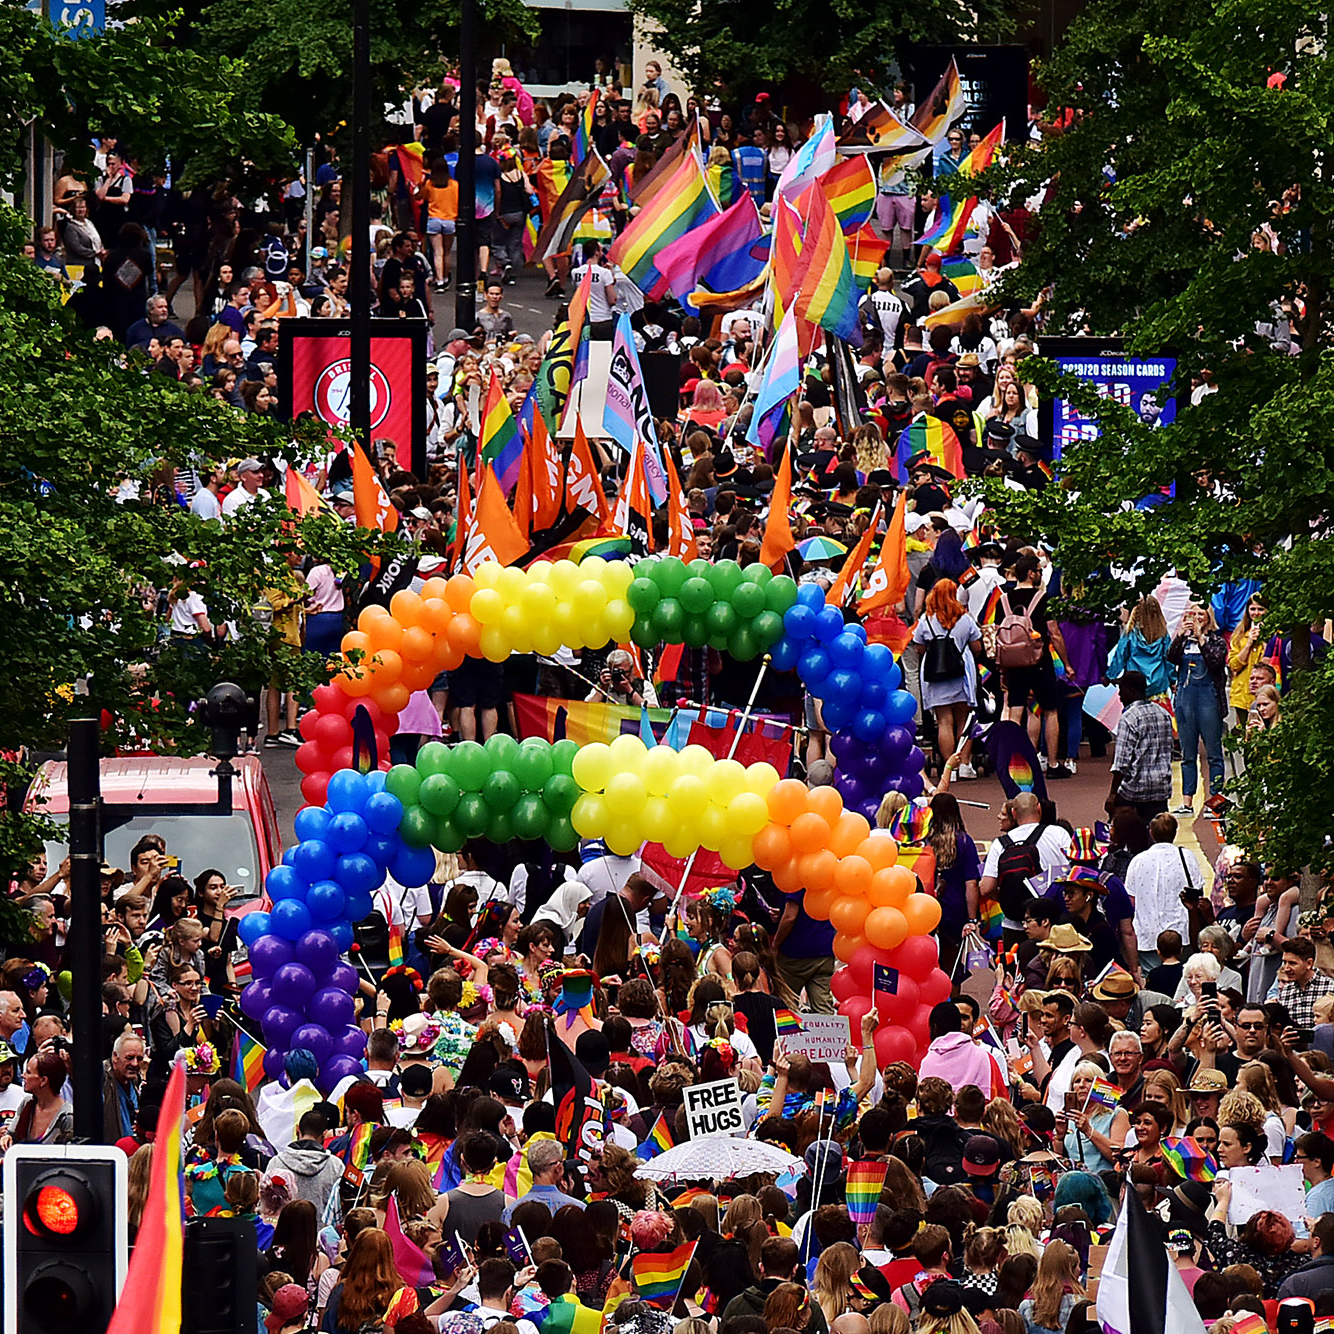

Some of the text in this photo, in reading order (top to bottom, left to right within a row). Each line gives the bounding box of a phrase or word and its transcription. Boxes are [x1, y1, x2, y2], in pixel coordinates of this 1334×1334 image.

[1101, 364, 1135, 377] SEASON
[1136, 364, 1166, 377] CARDS
[803, 1021, 845, 1029] EQUALITY
[804, 1036, 847, 1045] HUMANITY
[688, 1083, 738, 1111] FREE
[692, 1108, 742, 1136] HUGS
